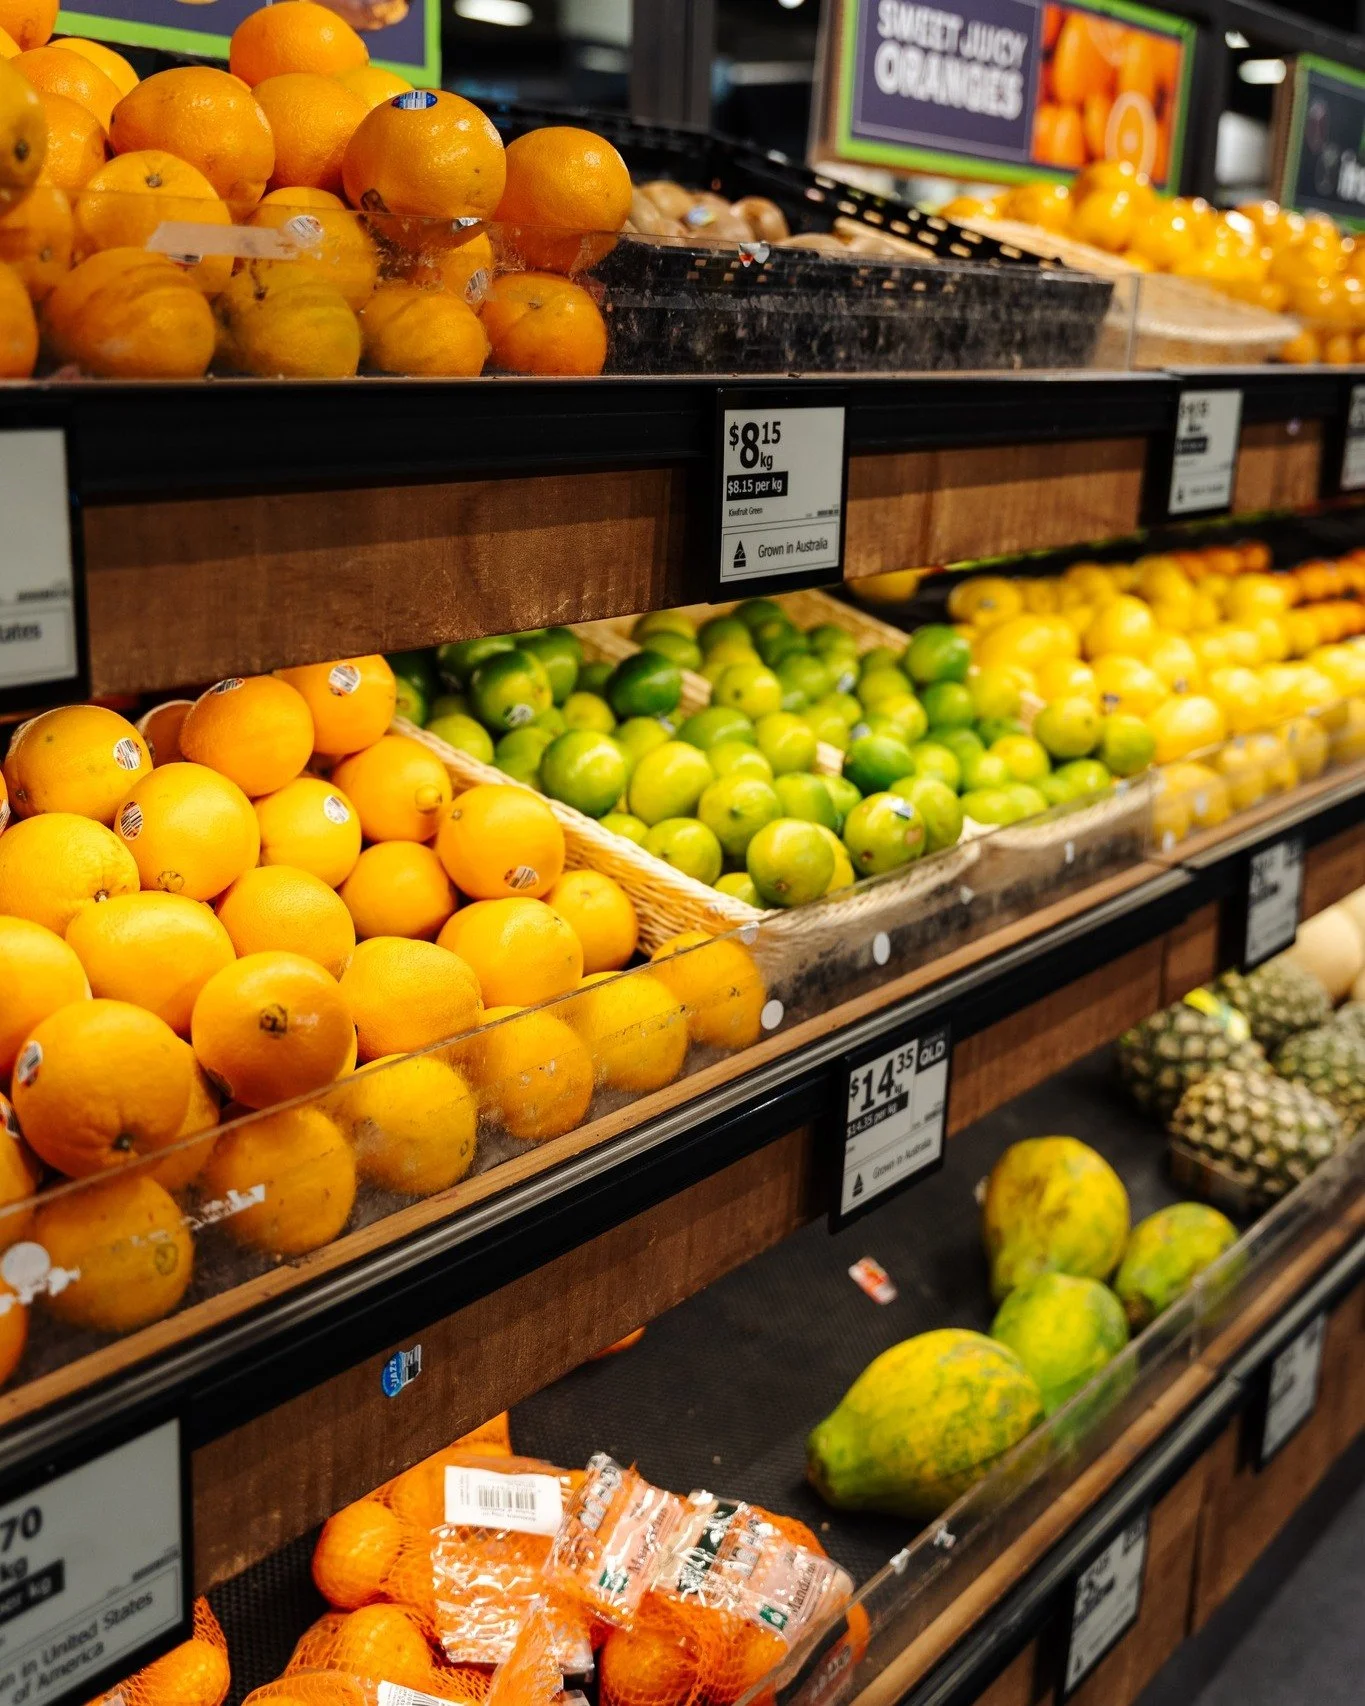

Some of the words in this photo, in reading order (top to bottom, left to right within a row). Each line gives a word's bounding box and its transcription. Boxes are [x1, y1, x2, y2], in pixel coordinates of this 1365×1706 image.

[877, 0, 964, 52] SWEET
[959, 20, 1028, 70] JUICY
[874, 38, 1024, 120] ORANGES
[760, 452, 773, 470] kg
[728, 479, 753, 496] $8.15
[755, 480, 770, 495] per
[772, 477, 783, 492] kg
[749, 506, 763, 516] Green
[758, 544, 784, 558] Grown
[786, 542, 794, 554] in
[796, 538, 828, 552] Australia
[920, 1040, 946, 1067] QLD
[390, 1358, 401, 1385] JAZZ
[43, 1620, 98, 1666] United
[103, 1591, 154, 1632] States
[37, 1640, 105, 1691] America
